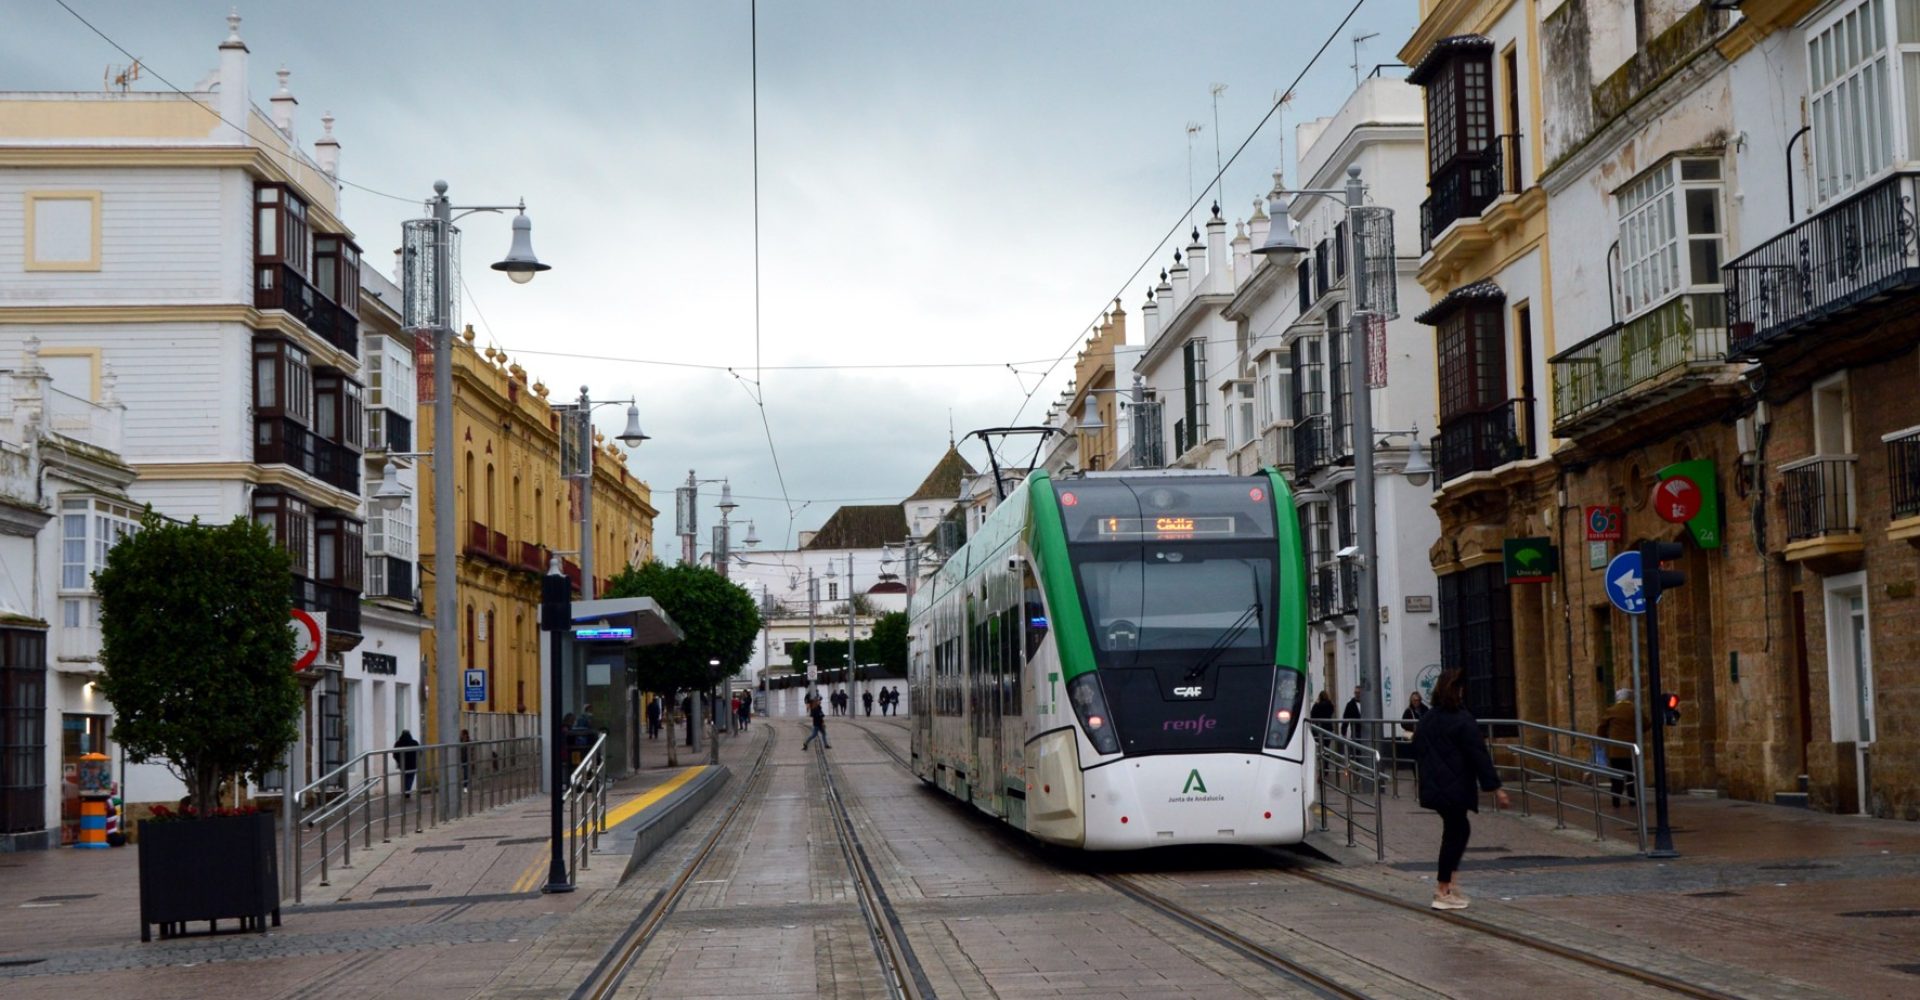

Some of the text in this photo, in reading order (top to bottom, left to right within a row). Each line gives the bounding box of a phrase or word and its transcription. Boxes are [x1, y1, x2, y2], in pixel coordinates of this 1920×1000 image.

[1109, 518, 1117, 532] 1
[1173, 686, 1203, 698] CAF
[1162, 713, 1217, 736] renfe
